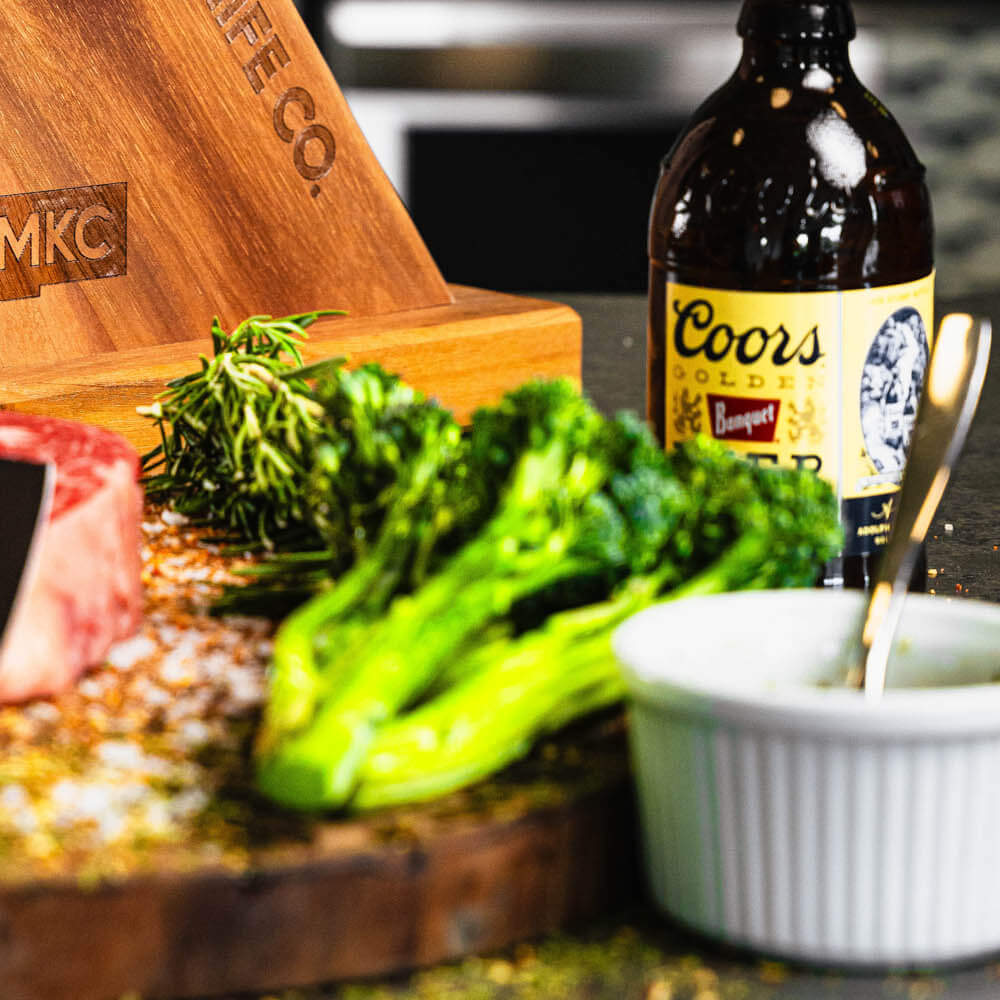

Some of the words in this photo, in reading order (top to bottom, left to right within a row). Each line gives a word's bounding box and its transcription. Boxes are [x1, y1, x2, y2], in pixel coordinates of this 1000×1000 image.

[273, 86, 336, 198] CO.
[672, 298, 825, 366] Coors
[714, 401, 775, 436] Banquet
